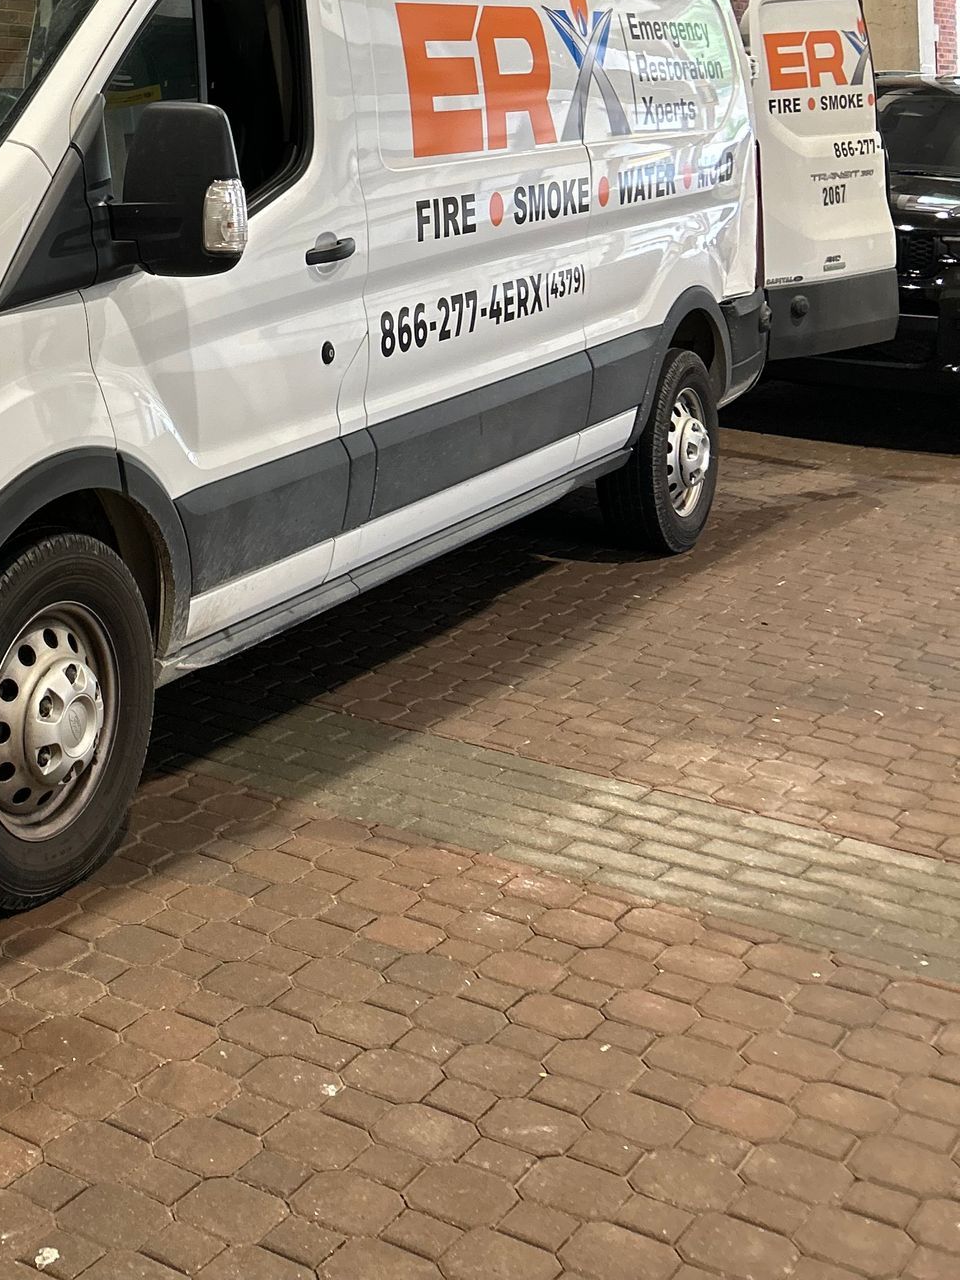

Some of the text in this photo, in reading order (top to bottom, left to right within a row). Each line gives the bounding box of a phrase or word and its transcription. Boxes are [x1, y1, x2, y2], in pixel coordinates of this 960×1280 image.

[626, 12, 710, 49] Emergency
[394, 1, 632, 158] ERX
[636, 54, 725, 83] Restoration
[641, 95, 697, 131] Xperts
[768, 93, 864, 115] FIRE SMOKE
[415, 193, 477, 242] FIRE
[513, 176, 590, 225] SMOKE
[618, 162, 677, 206] WATER
[822, 183, 847, 207] 2067
